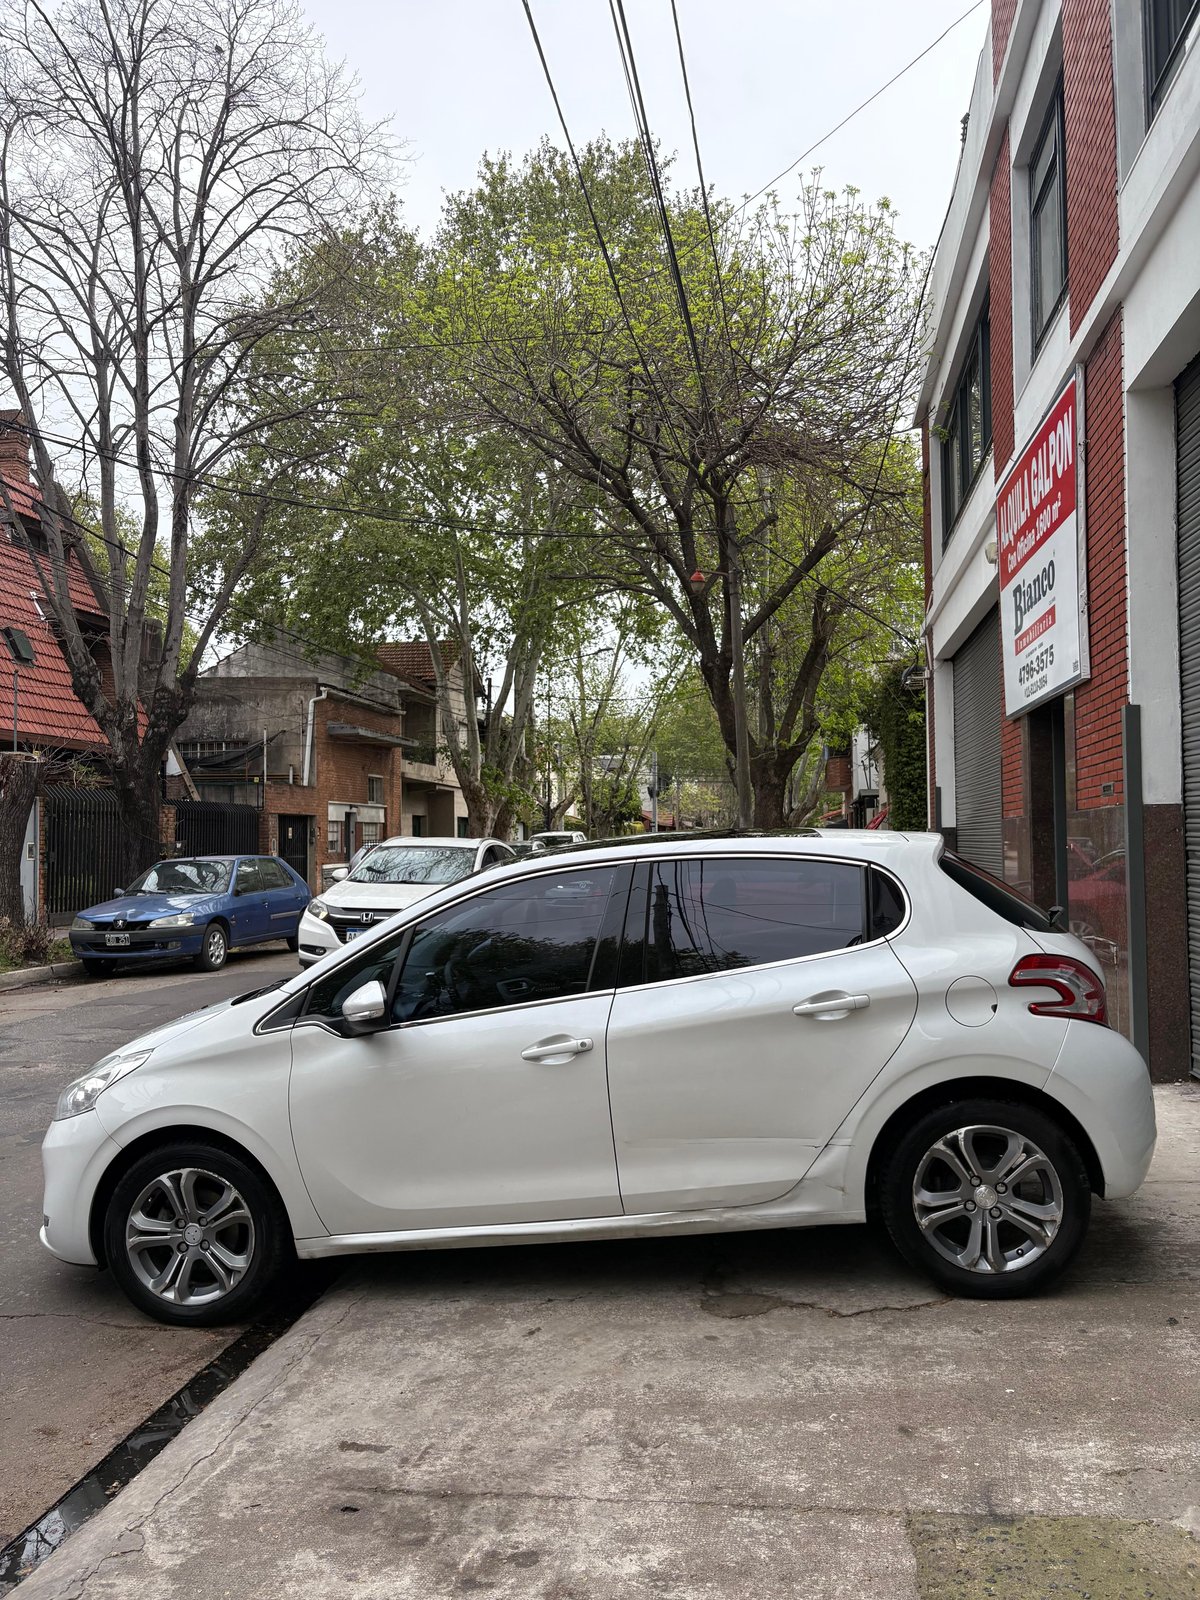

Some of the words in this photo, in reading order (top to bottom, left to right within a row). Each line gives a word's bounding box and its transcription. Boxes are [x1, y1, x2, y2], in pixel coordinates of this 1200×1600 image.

[1000, 469, 1031, 553] ALQUILA
[1031, 405, 1073, 511] GALPON
[1013, 559, 1056, 636] Bianco
[1019, 644, 1055, 686] 4796-3575
